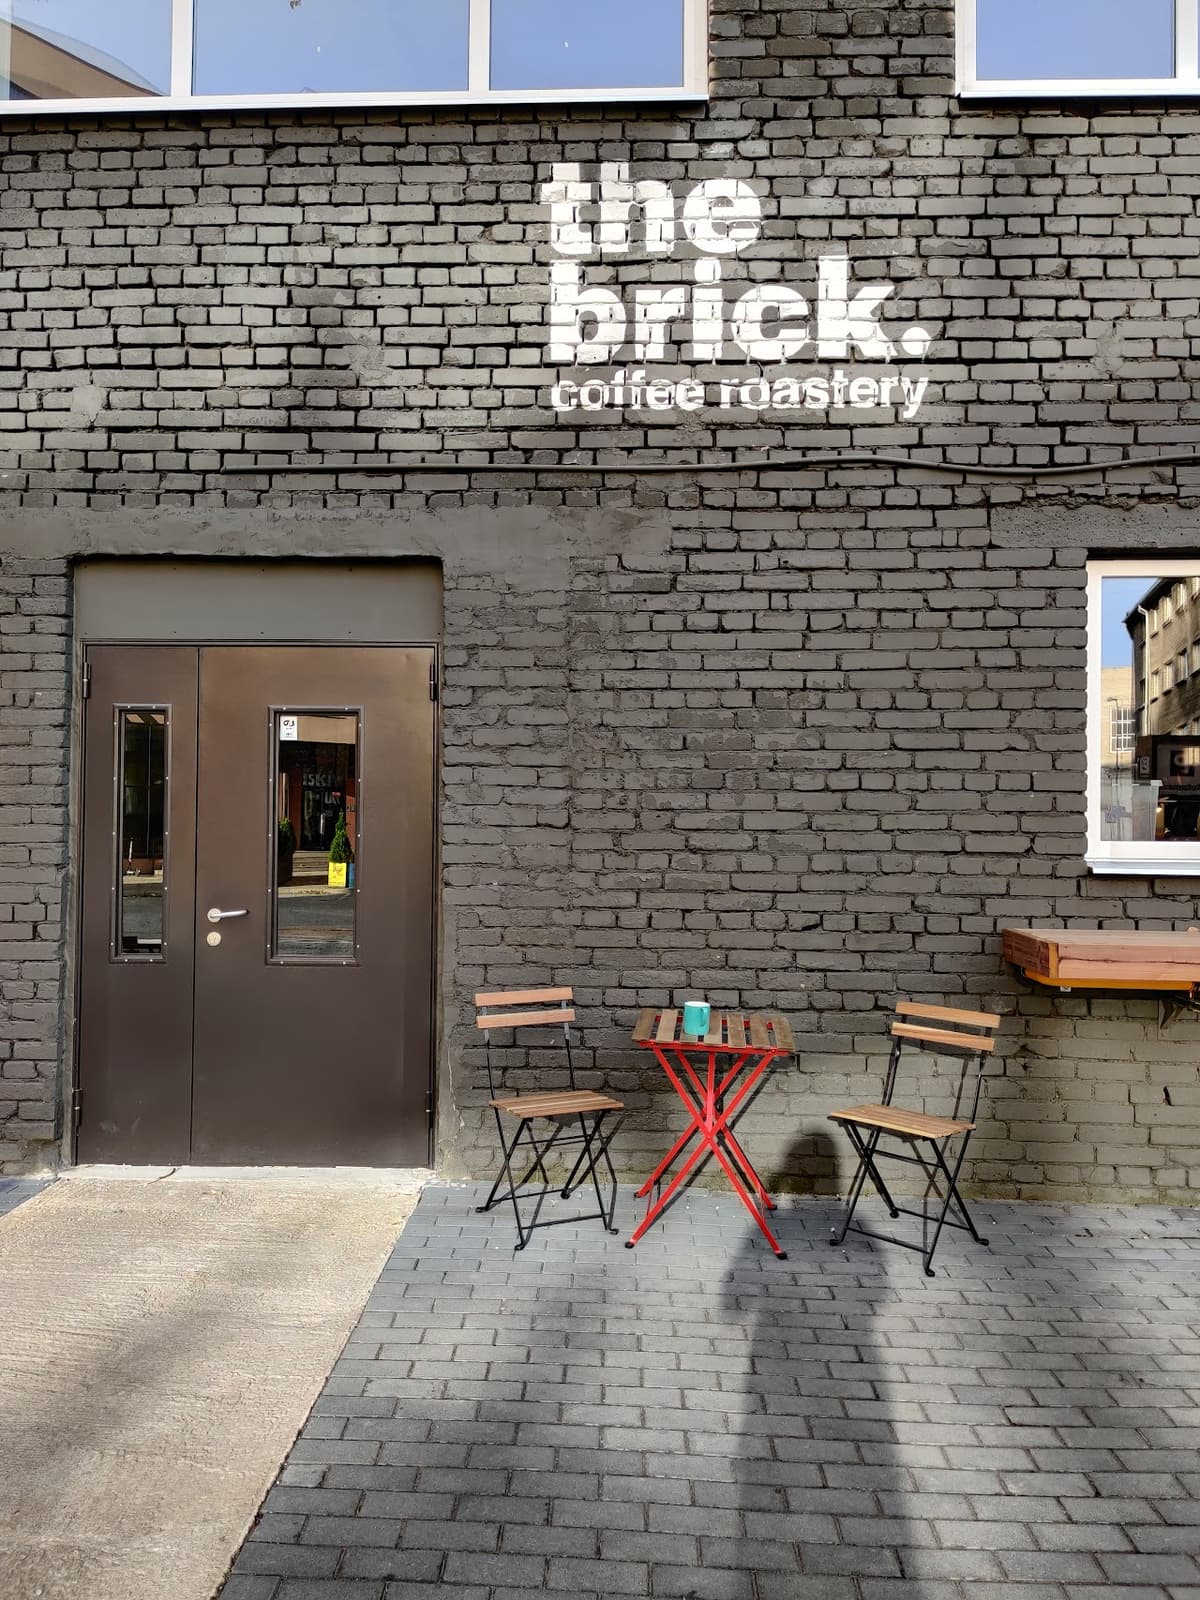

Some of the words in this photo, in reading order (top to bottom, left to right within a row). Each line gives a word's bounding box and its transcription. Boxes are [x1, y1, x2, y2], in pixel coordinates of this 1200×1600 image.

[540, 162, 762, 254] the
[549, 256, 931, 361] brick.
[551, 369, 706, 411] coffee
[719, 369, 929, 418] roastery
